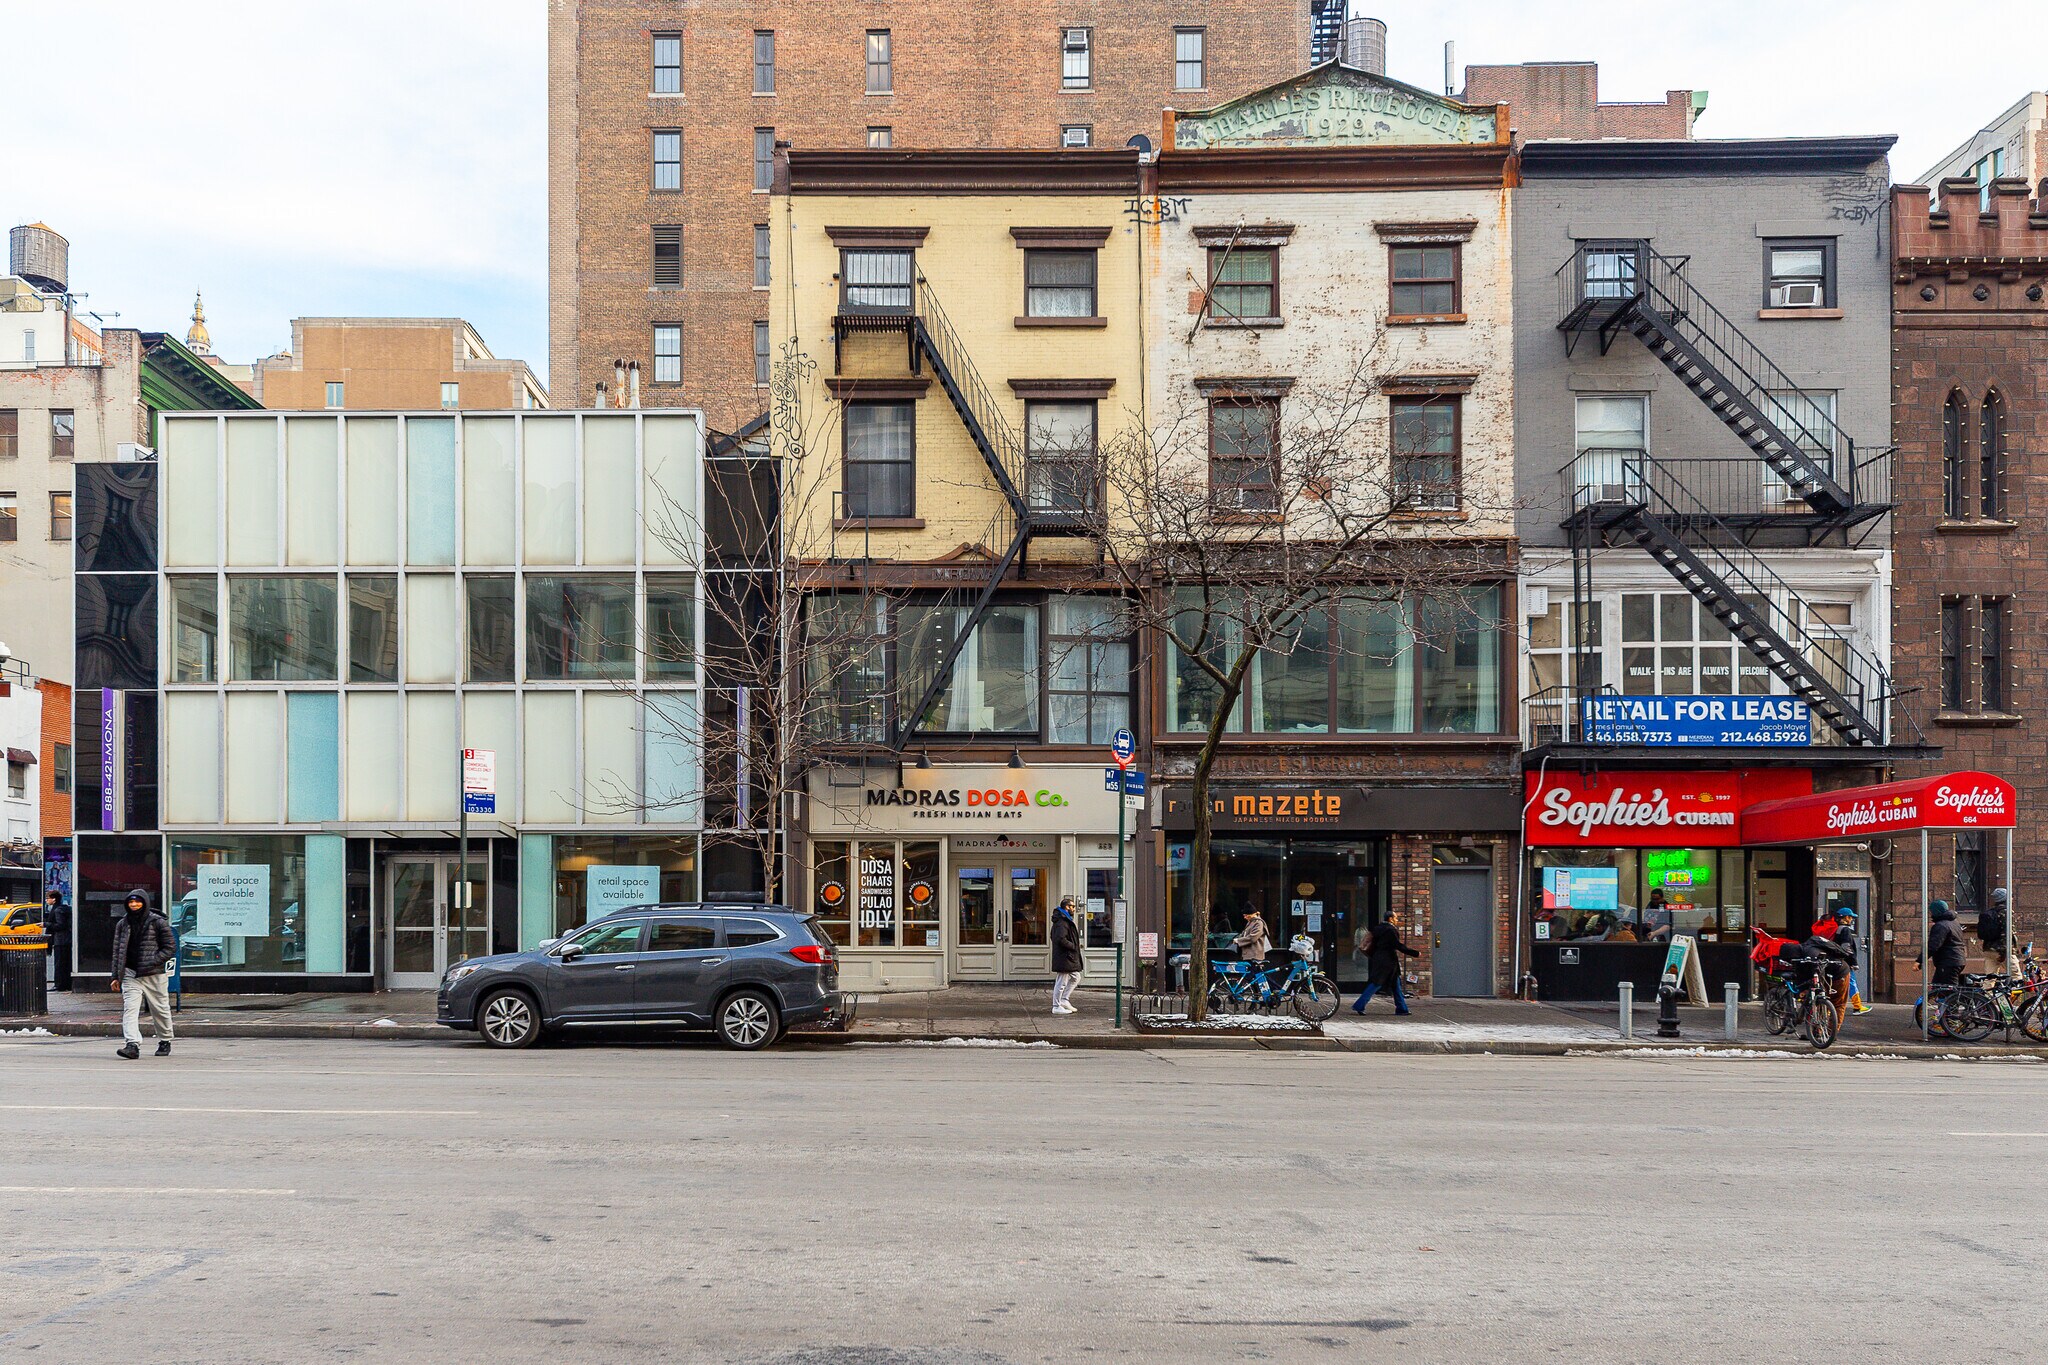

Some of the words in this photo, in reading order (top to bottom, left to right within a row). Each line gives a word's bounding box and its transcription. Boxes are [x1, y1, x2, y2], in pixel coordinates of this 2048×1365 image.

[1203, 90, 1321, 145] CHARLES
[1678, 666, 1692, 676] ARE
[1702, 666, 1729, 676] ALWAYS
[1740, 666, 1769, 676] WELCOME
[1586, 700, 1669, 720] RETAIL
[1675, 700, 1726, 720] FOR
[1731, 700, 1808, 720] LEASE
[1784, 723, 1807, 732] Mayer
[1720, 731, 1807, 742] 212.468.5926
[104, 709, 113, 811] 888-421-MONA
[466, 750, 473, 759] 3
[1106, 770, 1115, 779] M7
[1106, 781, 1119, 791] M55
[866, 789, 960, 806] MADRAS
[967, 789, 1030, 807] DOSA
[1035, 789, 1069, 807] Co.
[1233, 789, 1341, 816] mazete
[1934, 786, 2005, 813] Sophie's
[1168, 800, 1225, 813] ran
[1538, 787, 1673, 837] Sophie's
[1674, 812, 1735, 825] CUBAN
[912, 810, 947, 818] FRESH
[952, 810, 992, 818] INDIAN
[997, 810, 1023, 818] EATS
[1826, 800, 1878, 834] Sophie's
[1878, 806, 1917, 822] CUBAN
[1963, 815, 1977, 824] 664
[860, 859, 892, 875] DOSA
[208, 875, 230, 885] retail
[232, 877, 260, 887] space
[598, 876, 620, 886] retail
[622, 879, 650, 888] space
[860, 875, 893, 887] CHAATS
[212, 887, 255, 898] available
[602, 888, 645, 899] available
[860, 896, 893, 909] PULAO
[1293, 901, 1302, 912] A
[860, 909, 893, 929] IDLY
[1539, 924, 1546, 935] B
